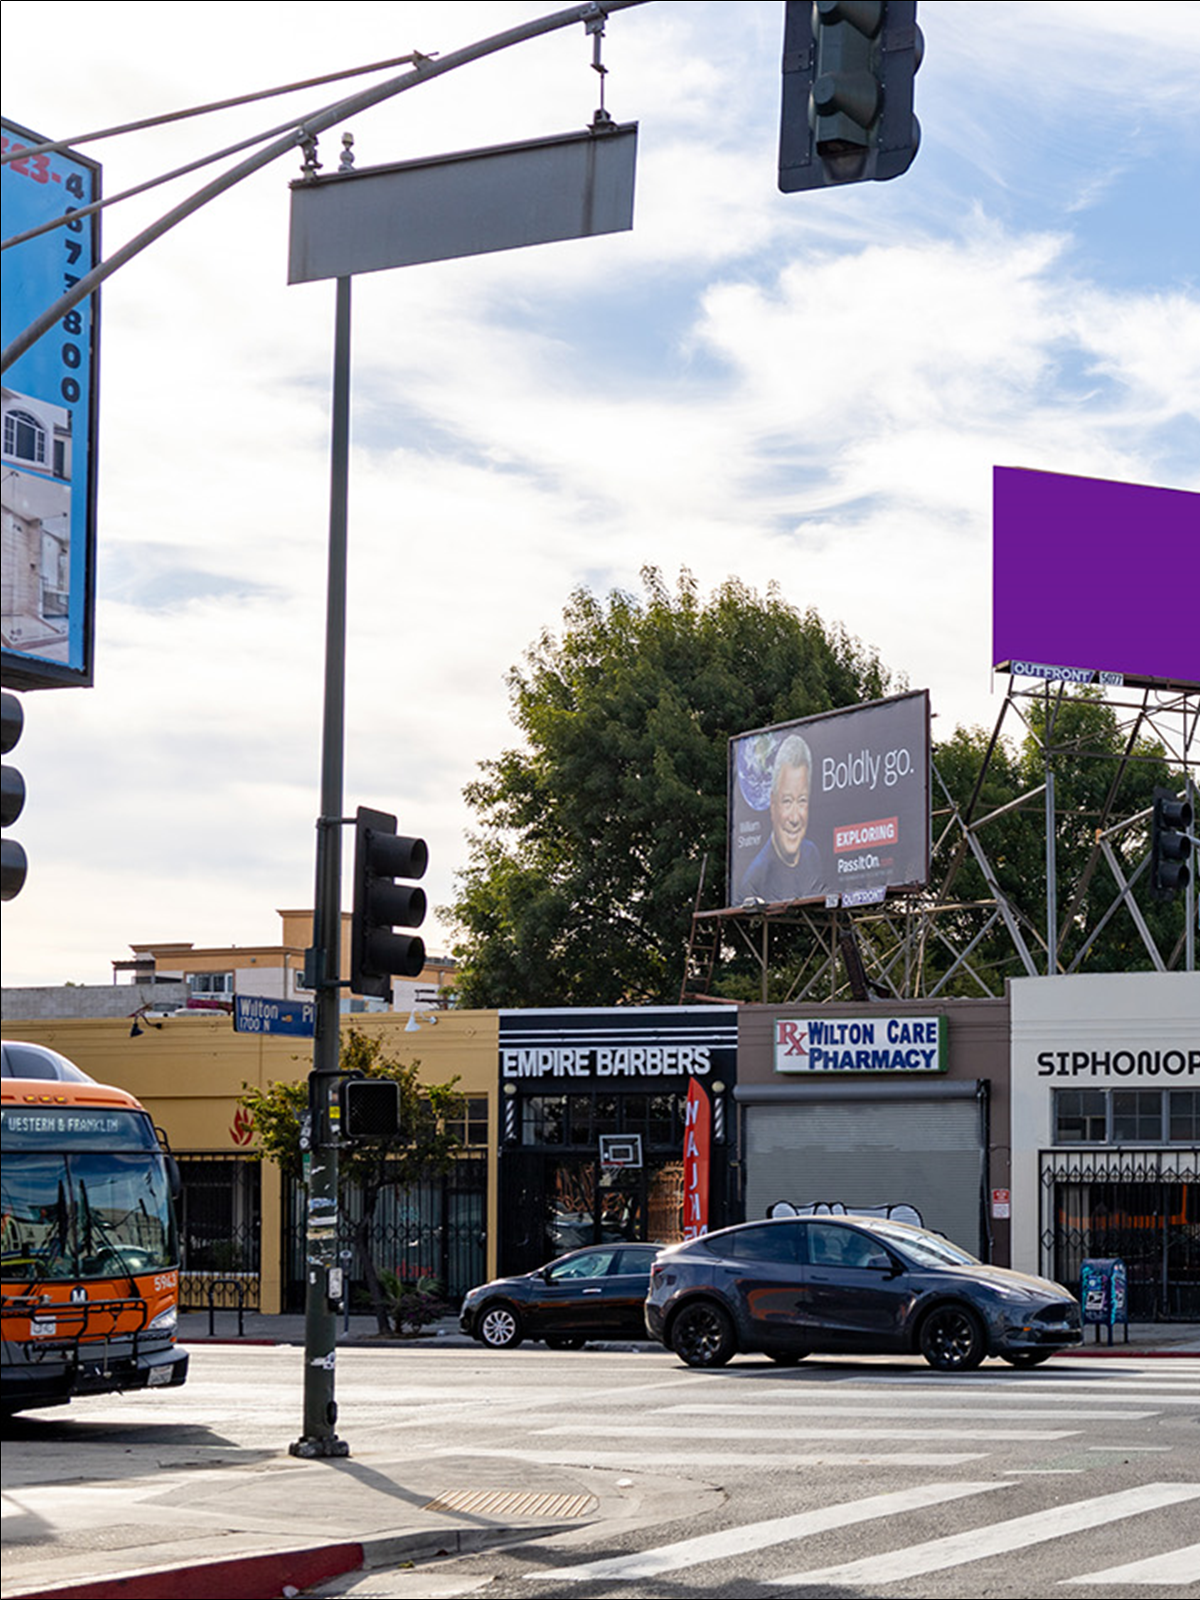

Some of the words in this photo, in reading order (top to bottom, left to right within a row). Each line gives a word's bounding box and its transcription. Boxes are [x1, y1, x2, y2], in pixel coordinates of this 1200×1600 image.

[1014, 662, 1091, 683] OUTFRONT
[822, 749, 881, 791] Boldly
[884, 748, 915, 786] go.
[836, 823, 895, 847] EXPLORING
[240, 998, 279, 1019] Wilton
[240, 1016, 260, 1031] 1700
[263, 1019, 271, 1032] N
[808, 1021, 875, 1045] WILTON
[887, 1019, 937, 1044] CARE
[503, 1049, 590, 1077] EMPIRE
[597, 1048, 711, 1076] BARBERS
[809, 1047, 936, 1069] PHARMACY
